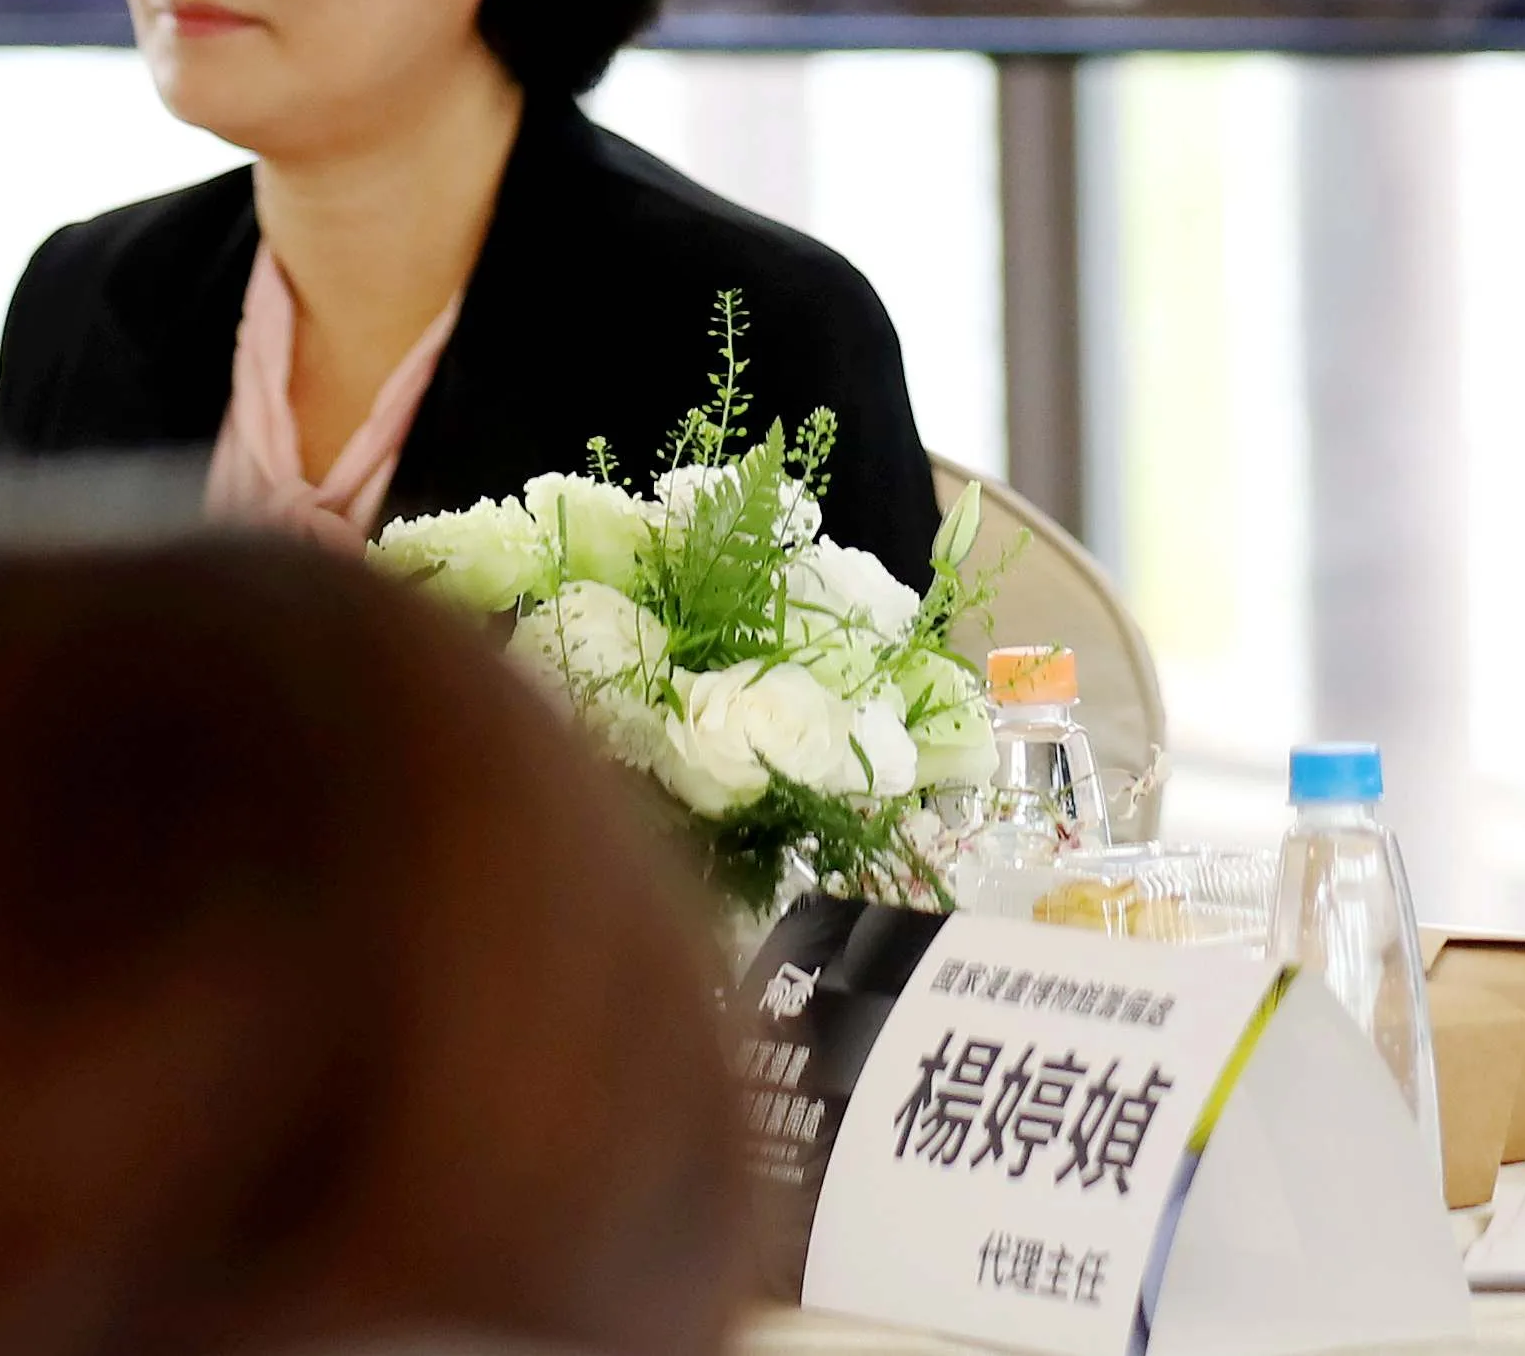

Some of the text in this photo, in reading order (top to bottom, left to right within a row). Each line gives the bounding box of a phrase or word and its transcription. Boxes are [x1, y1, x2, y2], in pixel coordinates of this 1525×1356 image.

[892, 1026, 1174, 1194] 楊婷媜
[977, 1230, 1110, 1306] 代理主任
